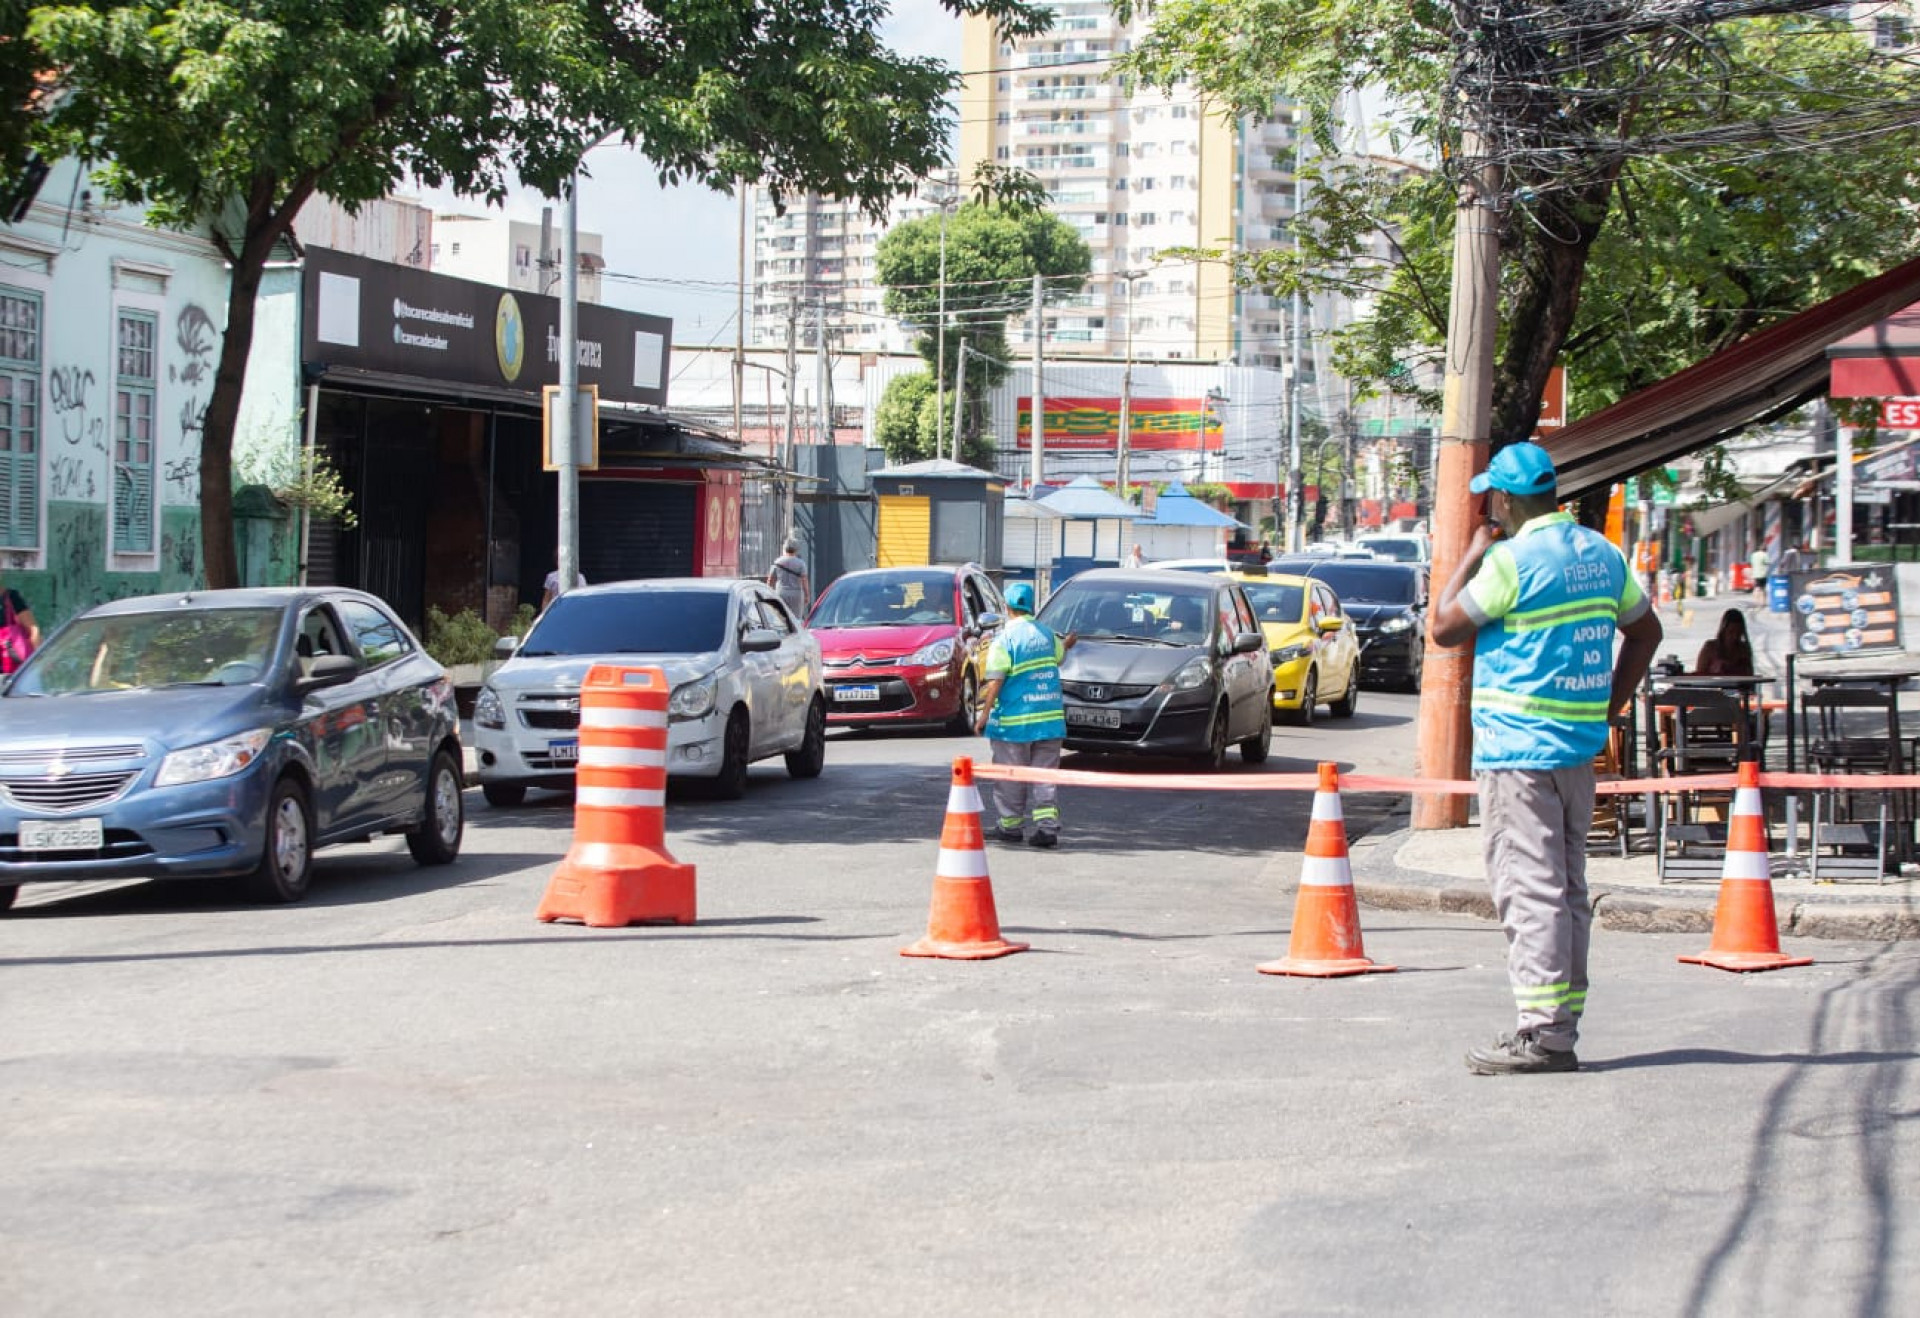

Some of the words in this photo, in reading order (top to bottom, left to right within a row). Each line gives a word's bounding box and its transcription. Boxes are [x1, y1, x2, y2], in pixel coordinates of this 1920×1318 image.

[1885, 402, 1920, 426] ES
[1564, 562, 1609, 583] FIBRA
[1573, 624, 1610, 643] APOIO
[1583, 650, 1601, 665] AO
